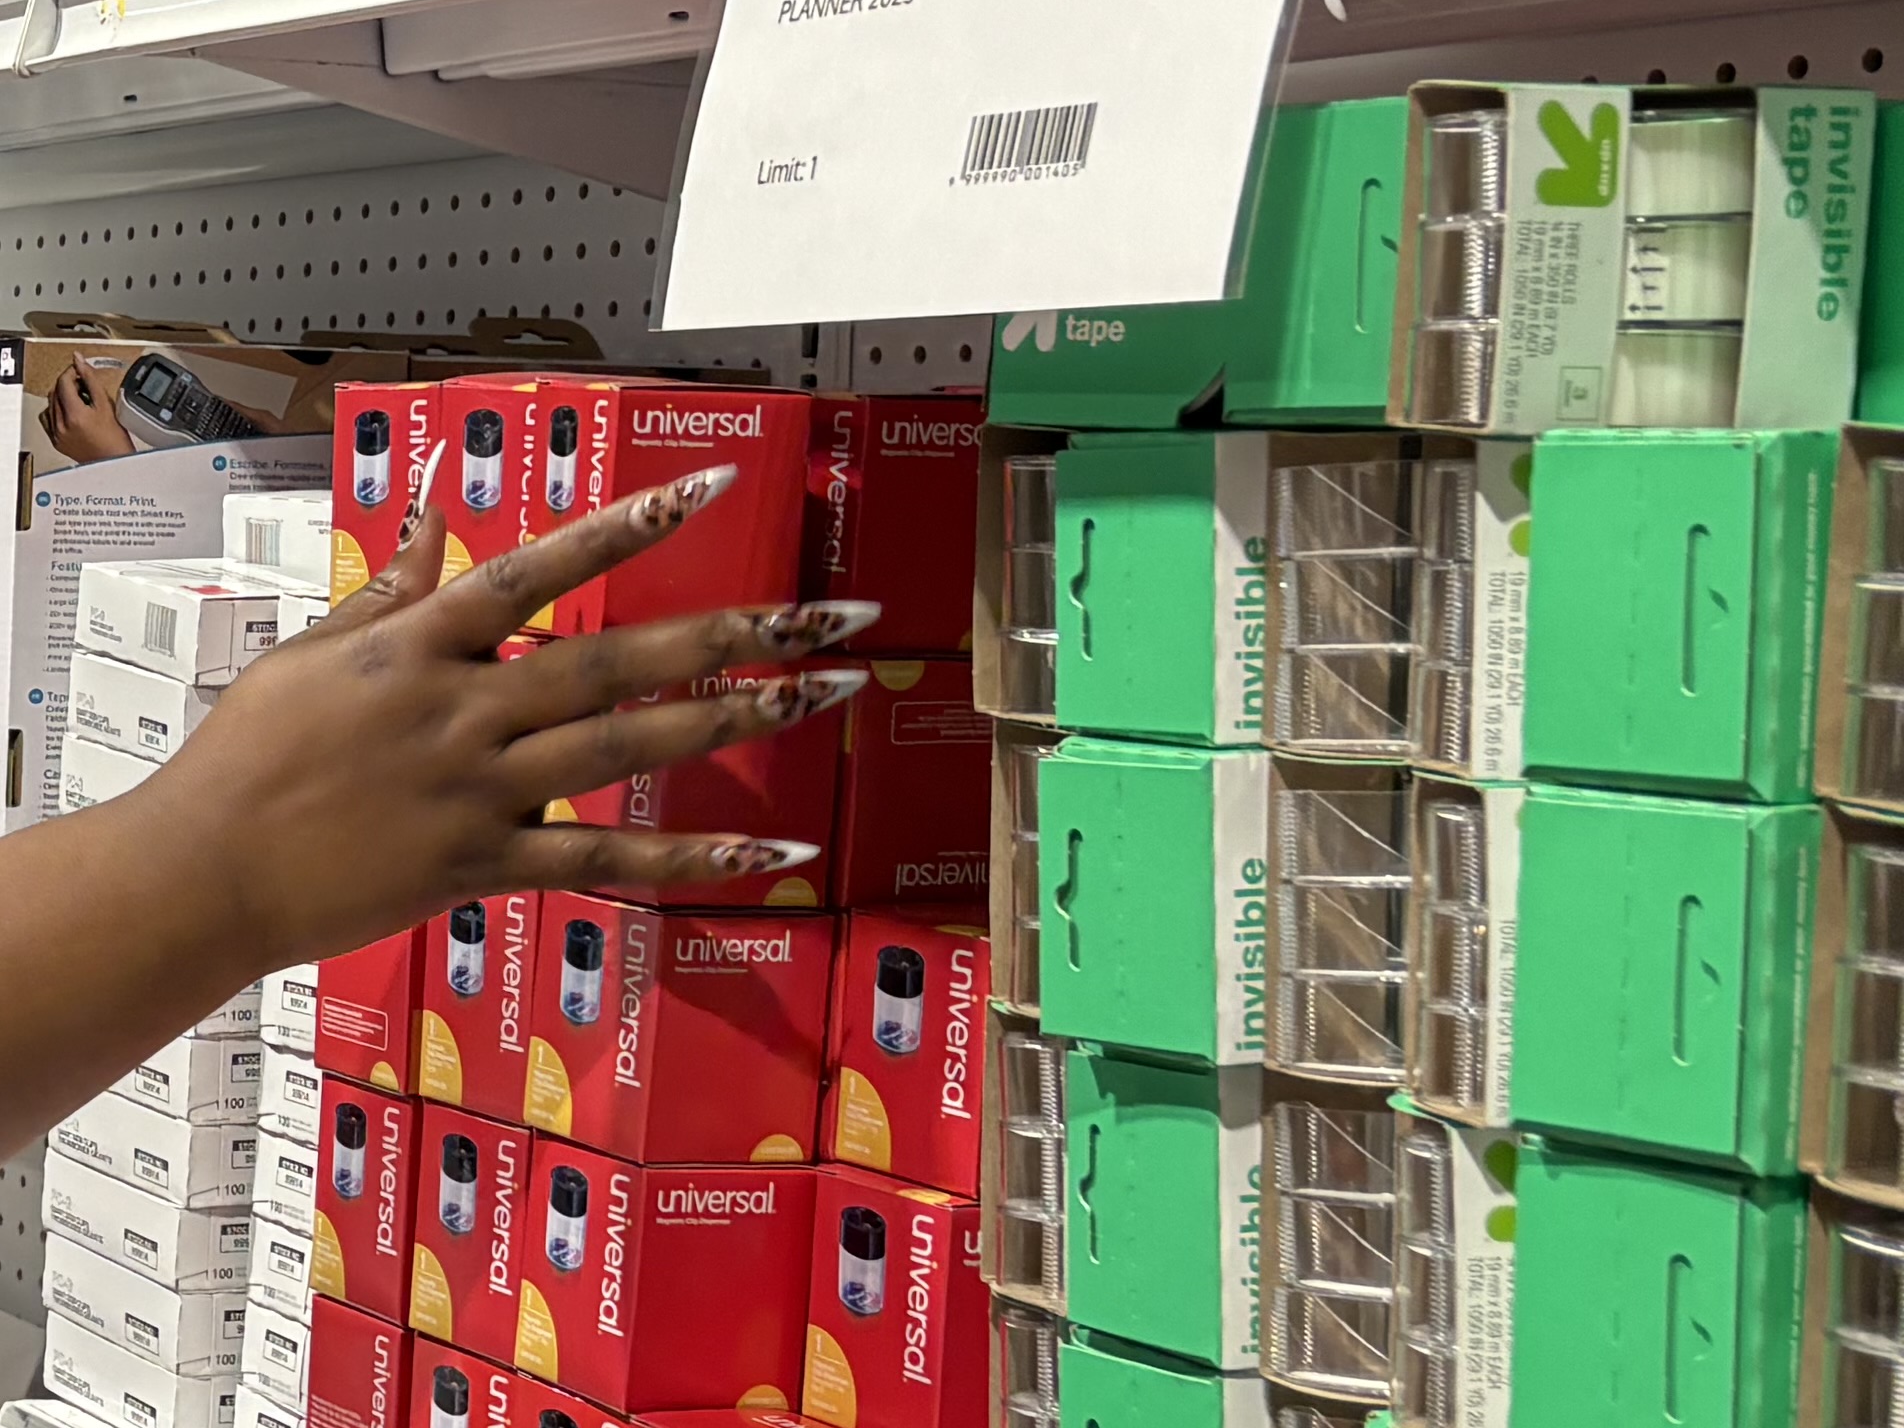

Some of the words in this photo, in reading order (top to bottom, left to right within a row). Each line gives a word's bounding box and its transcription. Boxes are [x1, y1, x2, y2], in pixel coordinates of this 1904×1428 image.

[756, 158, 806, 186] Limit:
[1785, 104, 1818, 219] tape
[1817, 104, 1861, 321] invisible
[1065, 316, 1127, 347] tape
[633, 404, 761, 437] universal
[1233, 536, 1267, 733] invisible
[499, 898, 526, 1054] universal
[676, 928, 792, 963] universal
[1236, 858, 1266, 1052] invisible
[231, 1010, 252, 1020] 100
[613, 923, 648, 1088] universal
[940, 948, 974, 1121] universal
[225, 1098, 245, 1109] 100
[225, 1184, 245, 1195] 100
[375, 1106, 400, 1257] universal
[488, 1138, 517, 1296] universal
[657, 1181, 775, 1214] universal
[212, 1267, 234, 1280] 100
[597, 1173, 632, 1337] universal
[903, 1213, 935, 1384] universal
[215, 1353, 236, 1366] 100
